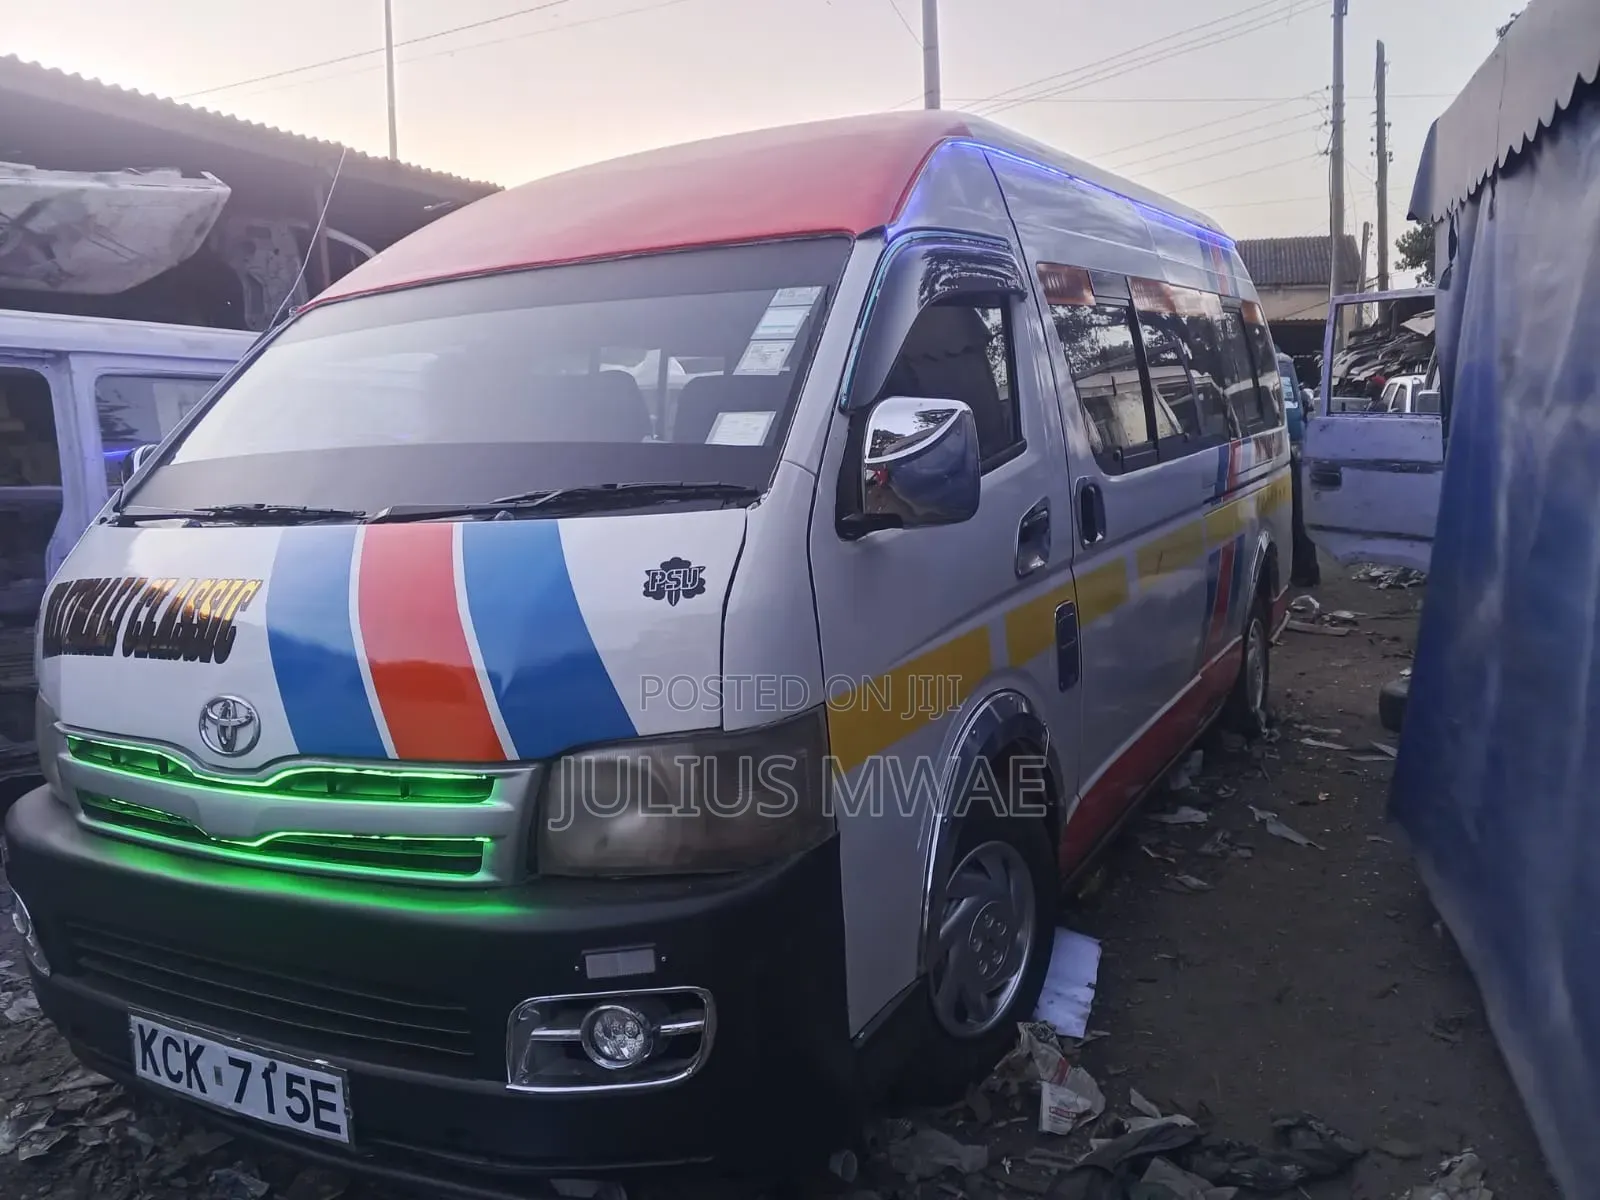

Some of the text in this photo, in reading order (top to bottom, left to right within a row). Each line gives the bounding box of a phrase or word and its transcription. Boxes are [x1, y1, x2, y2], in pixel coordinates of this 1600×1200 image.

[122, 577, 264, 665] CLASSIC
[646, 566, 702, 592] PSU
[137, 1023, 342, 1135] KCK 715E
